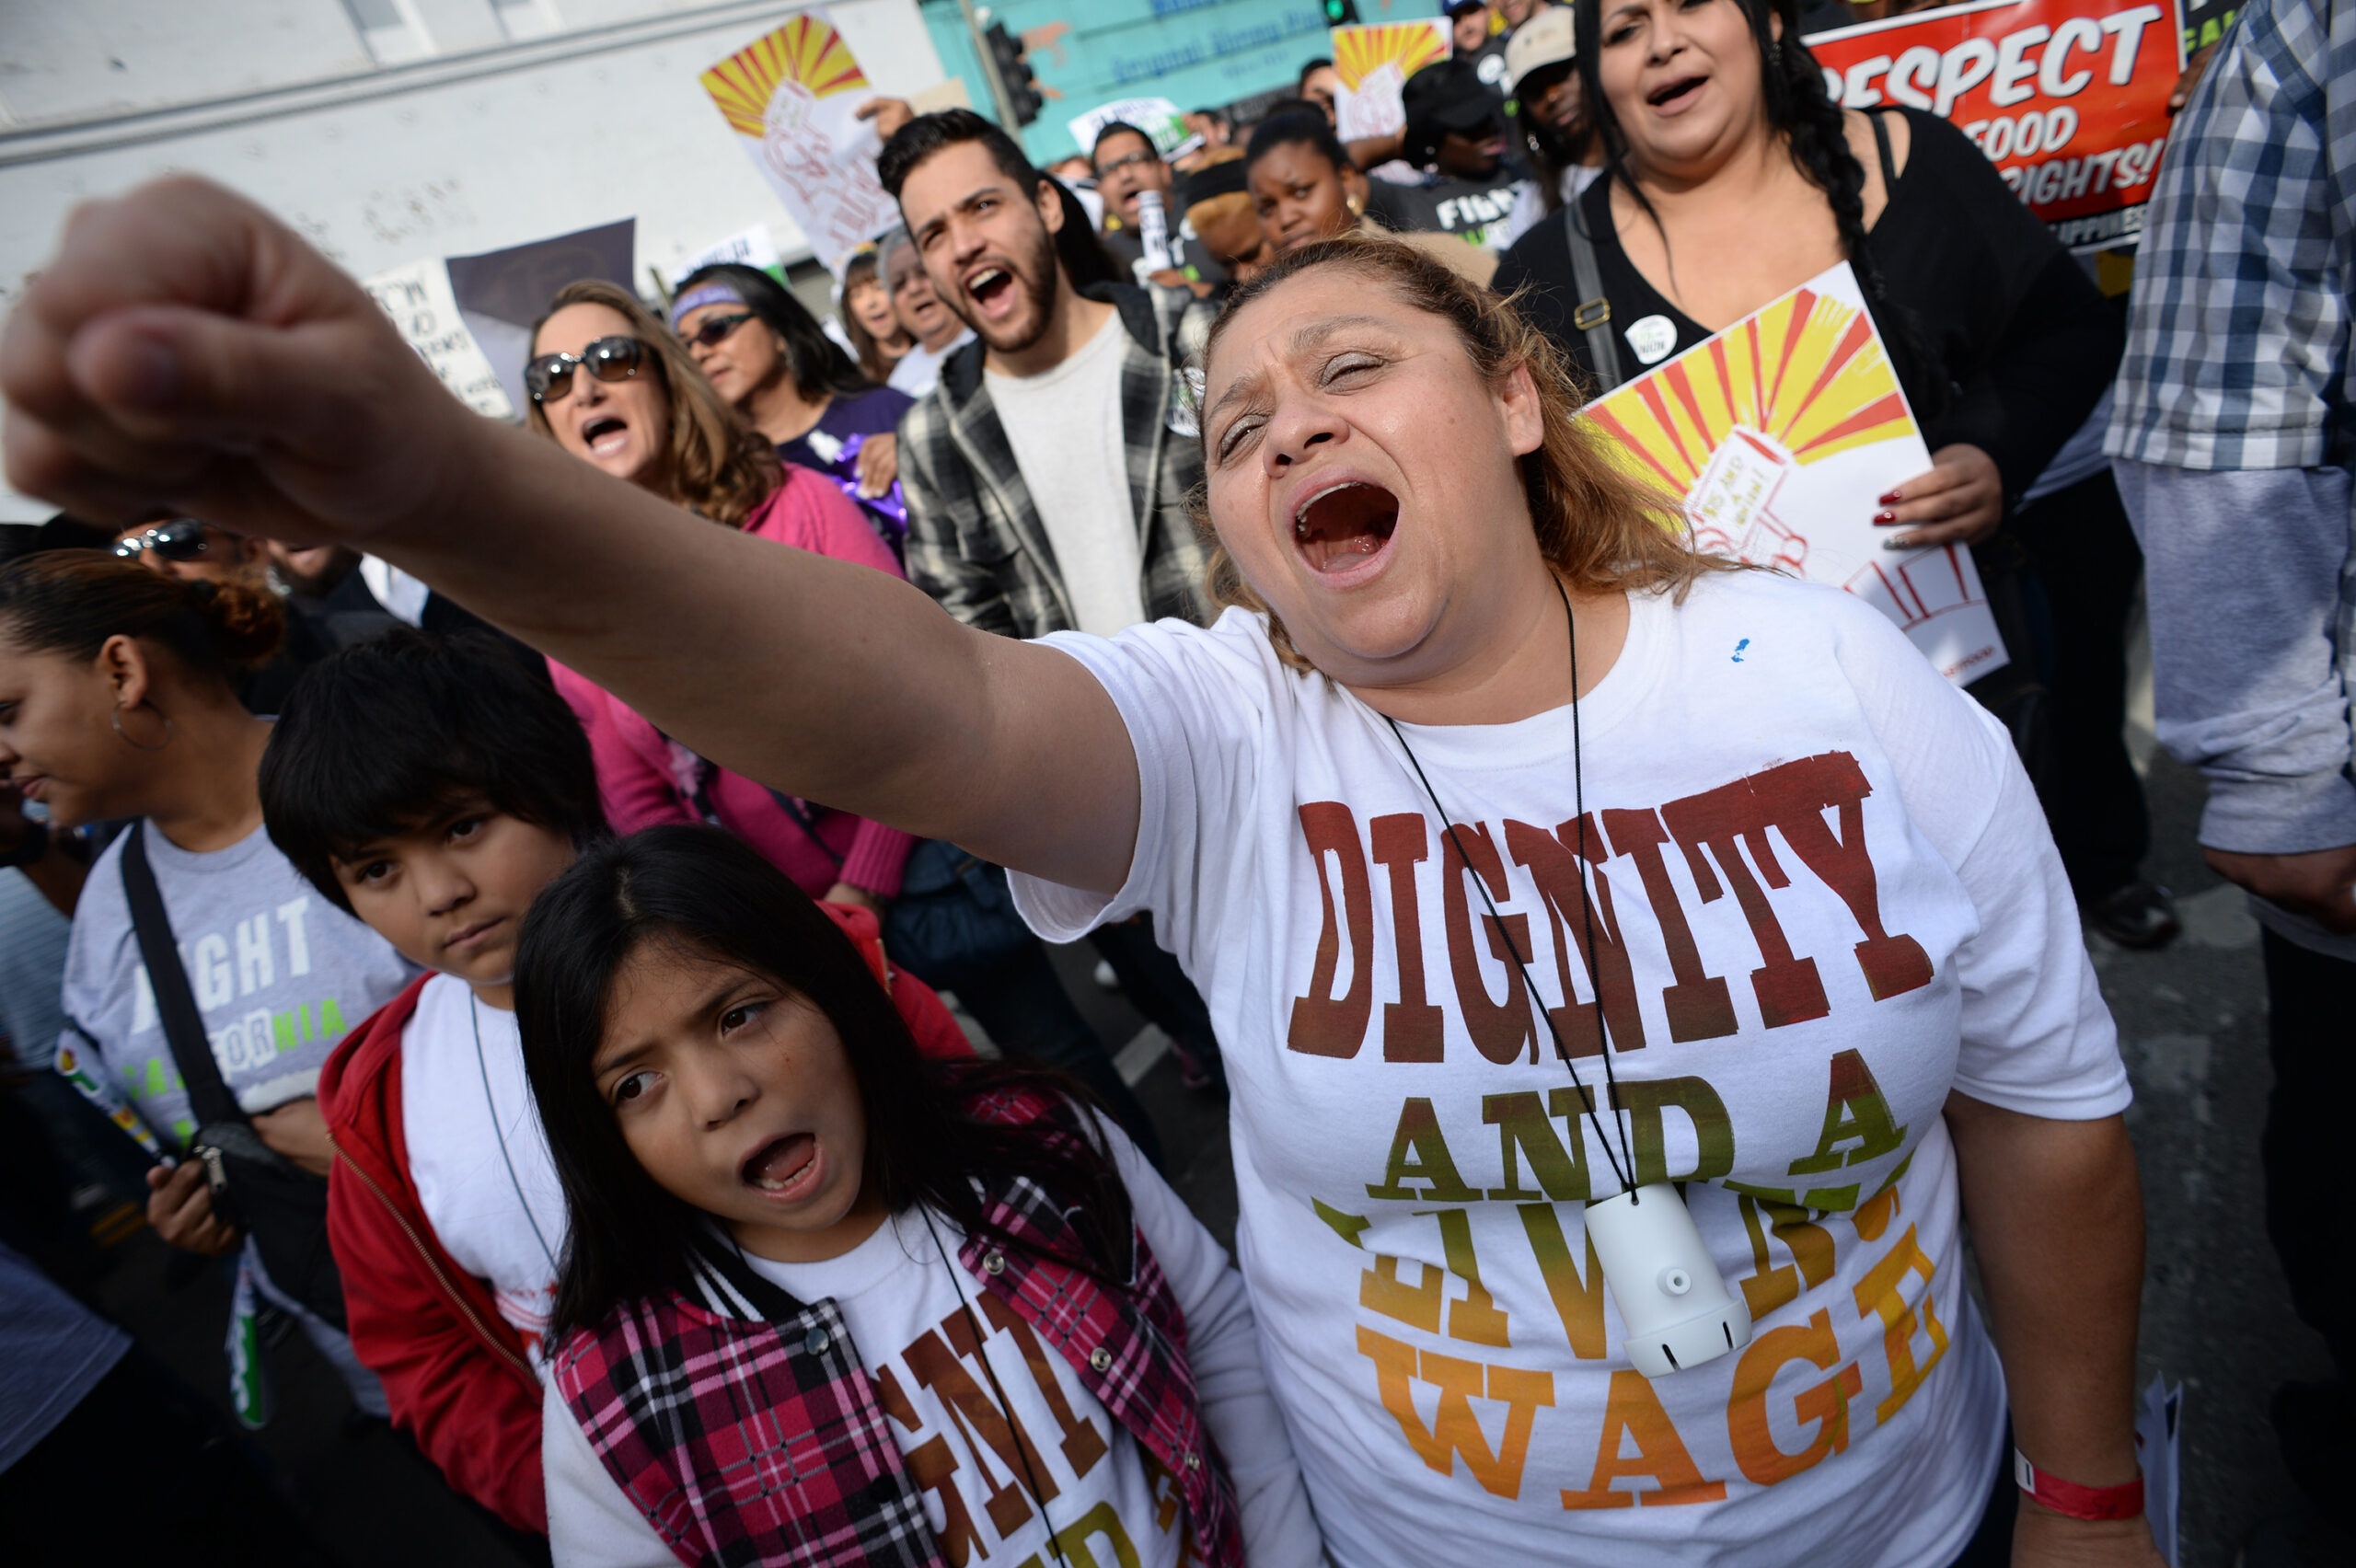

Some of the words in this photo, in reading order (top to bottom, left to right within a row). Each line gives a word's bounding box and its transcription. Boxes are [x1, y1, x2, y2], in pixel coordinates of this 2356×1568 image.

[1287, 750, 1935, 1066] DIGNITY
[1365, 1075, 1735, 1204] AND
[1788, 1047, 1909, 1176] A
[1355, 1221, 1950, 1511] WAGE
